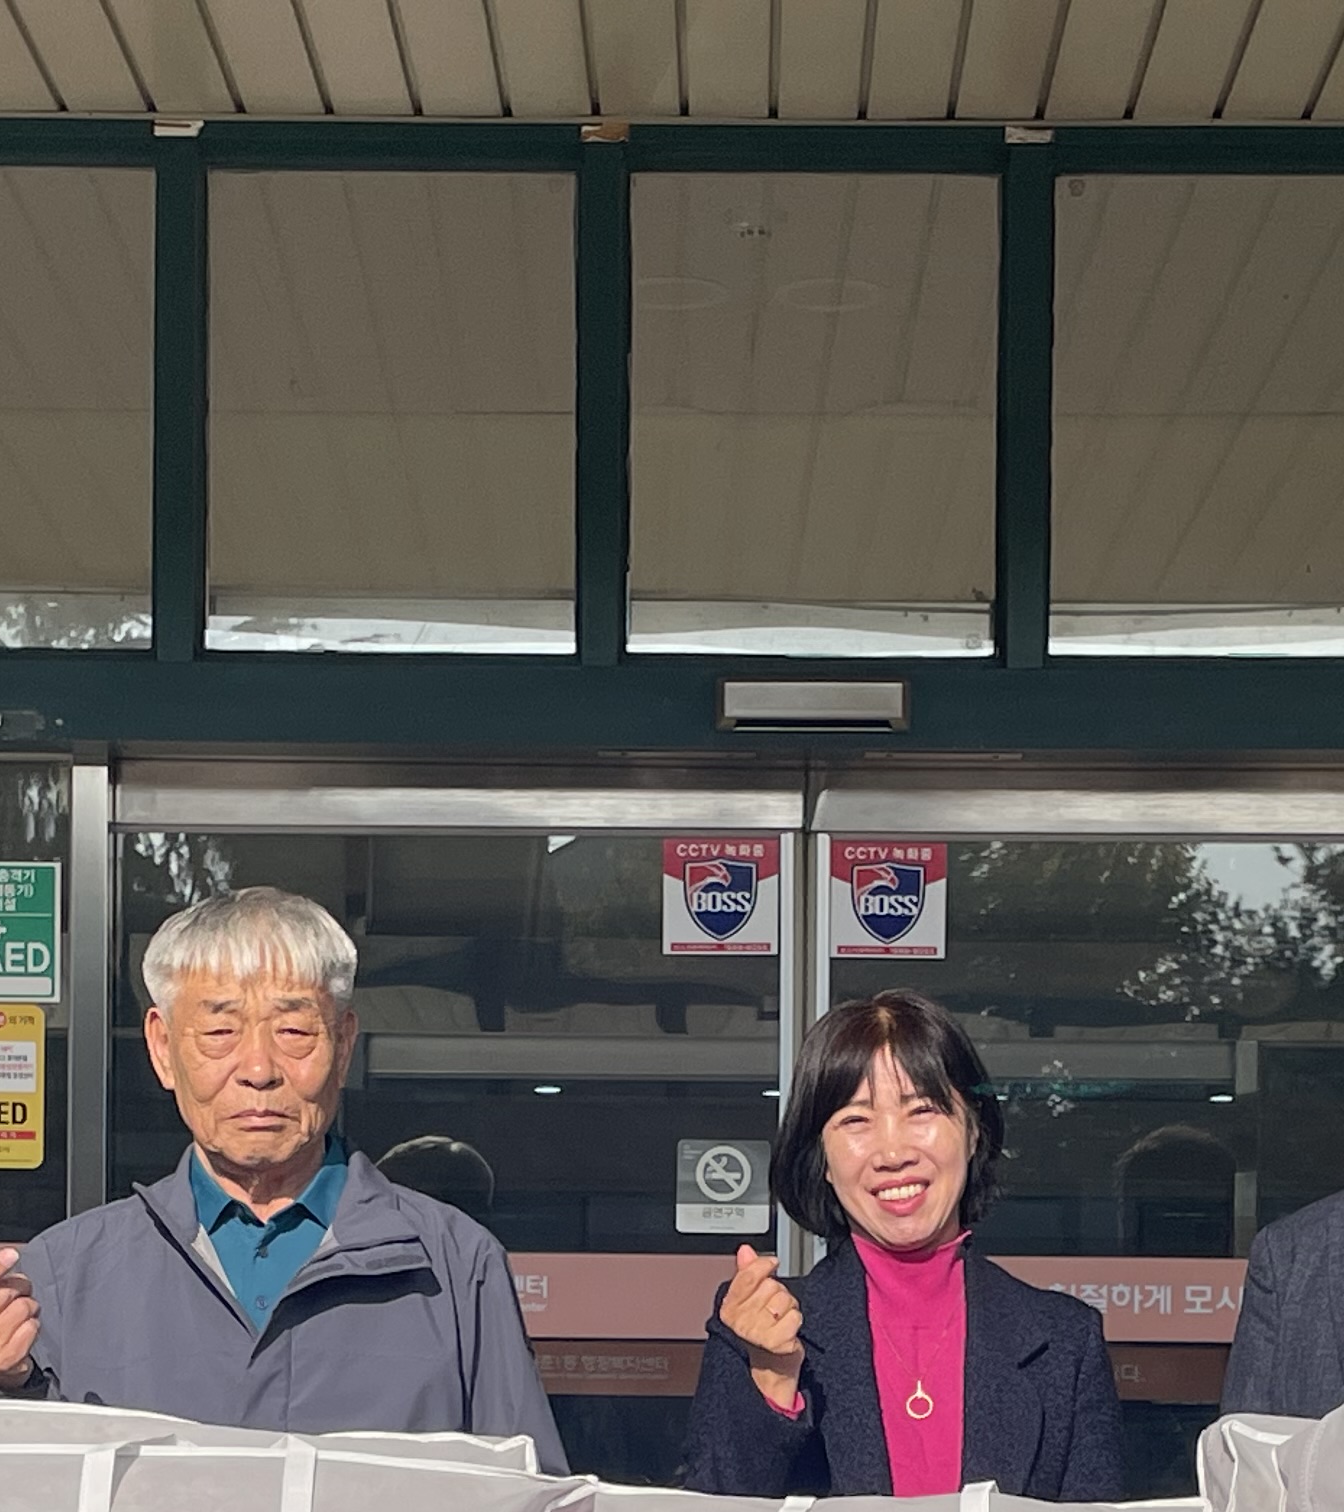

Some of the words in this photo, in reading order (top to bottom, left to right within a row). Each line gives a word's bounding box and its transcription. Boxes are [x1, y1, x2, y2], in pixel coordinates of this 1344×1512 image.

[676, 843, 721, 857] CCTV
[844, 846, 889, 860] CCTV
[892, 847, 933, 861] 녹화중
[692, 891, 752, 913] BOSS
[859, 894, 919, 916] BOSS
